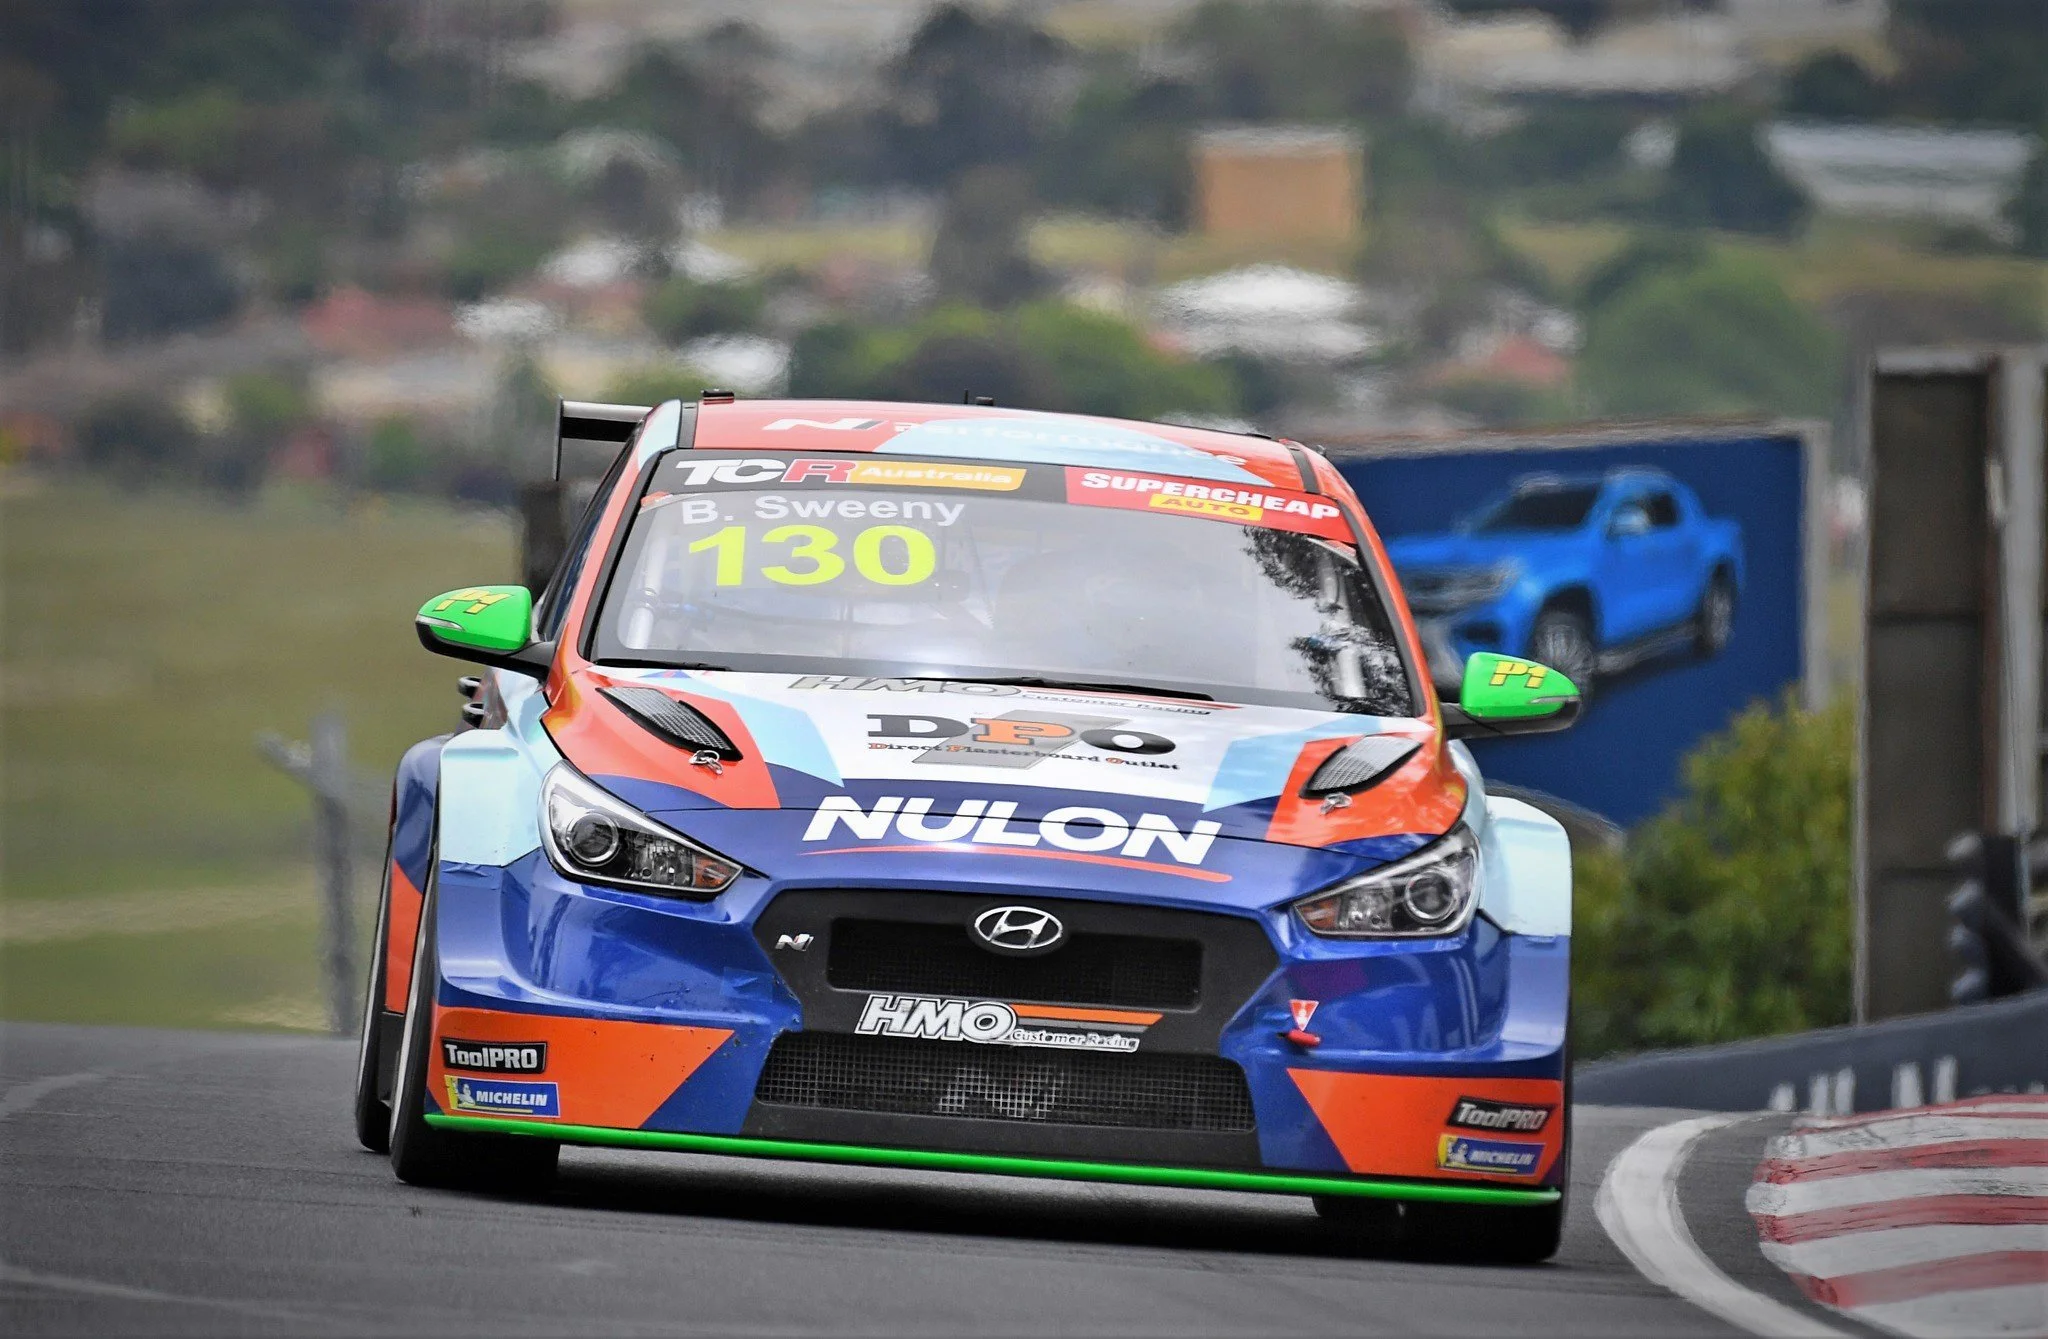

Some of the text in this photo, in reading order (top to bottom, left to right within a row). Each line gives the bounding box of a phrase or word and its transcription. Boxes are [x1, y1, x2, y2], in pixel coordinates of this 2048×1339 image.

[684, 458, 1014, 485] TCR Australia
[683, 494, 966, 526] B. Sweeny
[1081, 472, 1341, 520] SUPERCHEAP
[1161, 497, 1250, 516] AUTO
[688, 524, 937, 586] 130
[1489, 660, 1548, 689] P1
[788, 676, 1212, 716] HMO Customer Racing
[866, 713, 1177, 756] DPO
[868, 742, 1180, 770] Direct Plasterboard Outlet
[802, 796, 1222, 864] NULON
[855, 994, 1138, 1049] HMO Customer Racing
[445, 1043, 538, 1069] ToolPRO
[476, 1090, 548, 1107] MICHELIN
[1458, 1103, 1548, 1130] ToolPRO
[1469, 1150, 1536, 1165] MICHELIN
